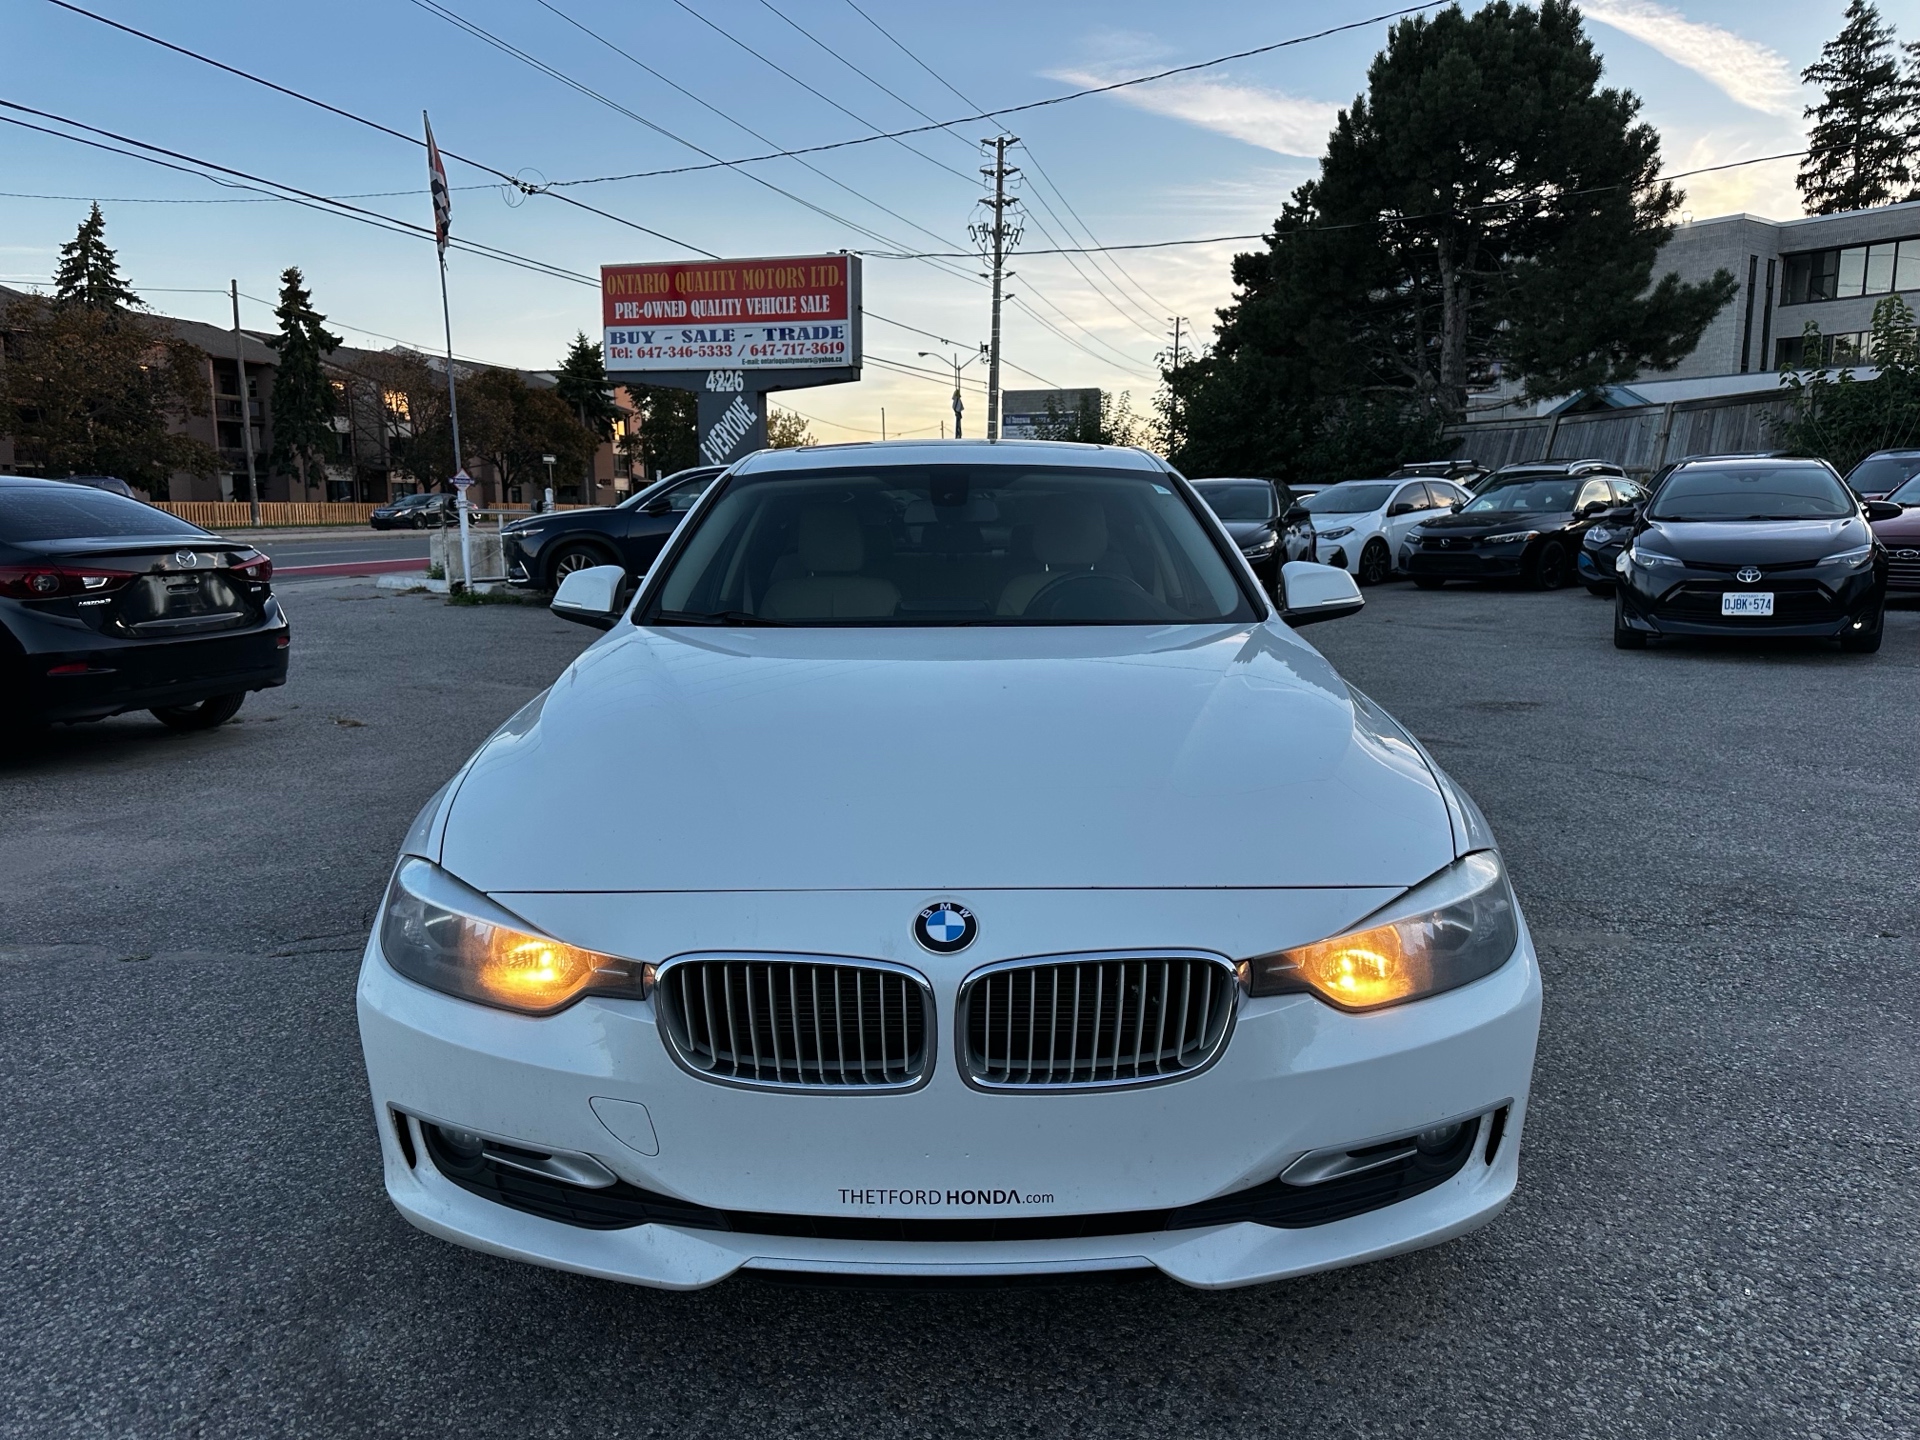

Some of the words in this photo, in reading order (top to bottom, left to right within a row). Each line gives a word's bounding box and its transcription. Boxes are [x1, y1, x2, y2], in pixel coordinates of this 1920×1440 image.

[606, 272, 670, 296] ONTARIO
[674, 269, 738, 295] QUALITY
[742, 266, 806, 291] MOTORS
[810, 265, 844, 288] LTD.
[614, 300, 687, 320] PRE-OWNED
[690, 298, 742, 319] QUALITY
[746, 296, 797, 316] VEHICLE
[800, 294, 830, 314] SALE
[609, 330, 656, 345] BUY
[681, 328, 735, 344] SALE
[762, 325, 845, 341] TRADE
[609, 346, 633, 359] Tel:
[636, 344, 733, 359] 647-346-5333
[749, 341, 845, 357] 647-717-3619
[705, 370, 744, 392] 4226
[700, 395, 758, 465] EVERYONE
[920, 903, 972, 919] BMW
[838, 1188, 942, 1205] THETFORD
